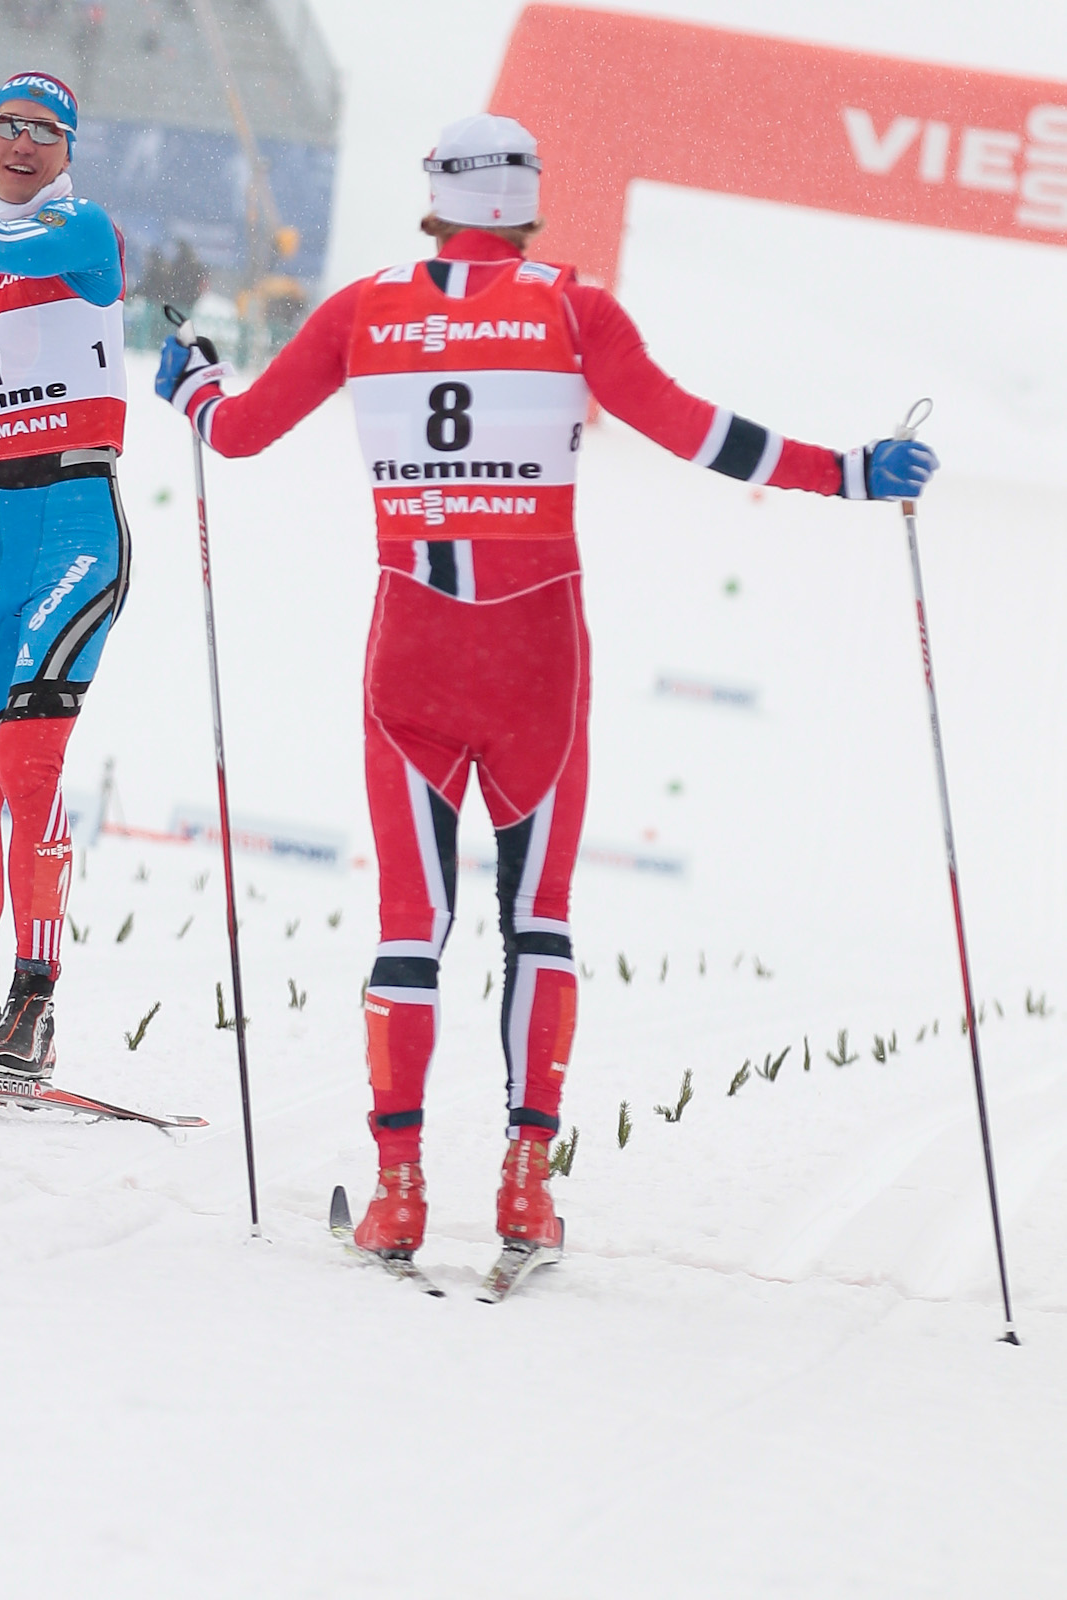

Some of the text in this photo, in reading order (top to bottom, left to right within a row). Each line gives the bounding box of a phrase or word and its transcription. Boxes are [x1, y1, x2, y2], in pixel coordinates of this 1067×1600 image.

[368, 314, 547, 353] VIESSMANN
[91, 341, 107, 369] 1
[425, 381, 473, 452] 8
[569, 421, 584, 453] 8
[372, 456, 544, 482] fiemme
[382, 488, 538, 527] VIESSMANN
[28, 553, 99, 632] SCANIA
